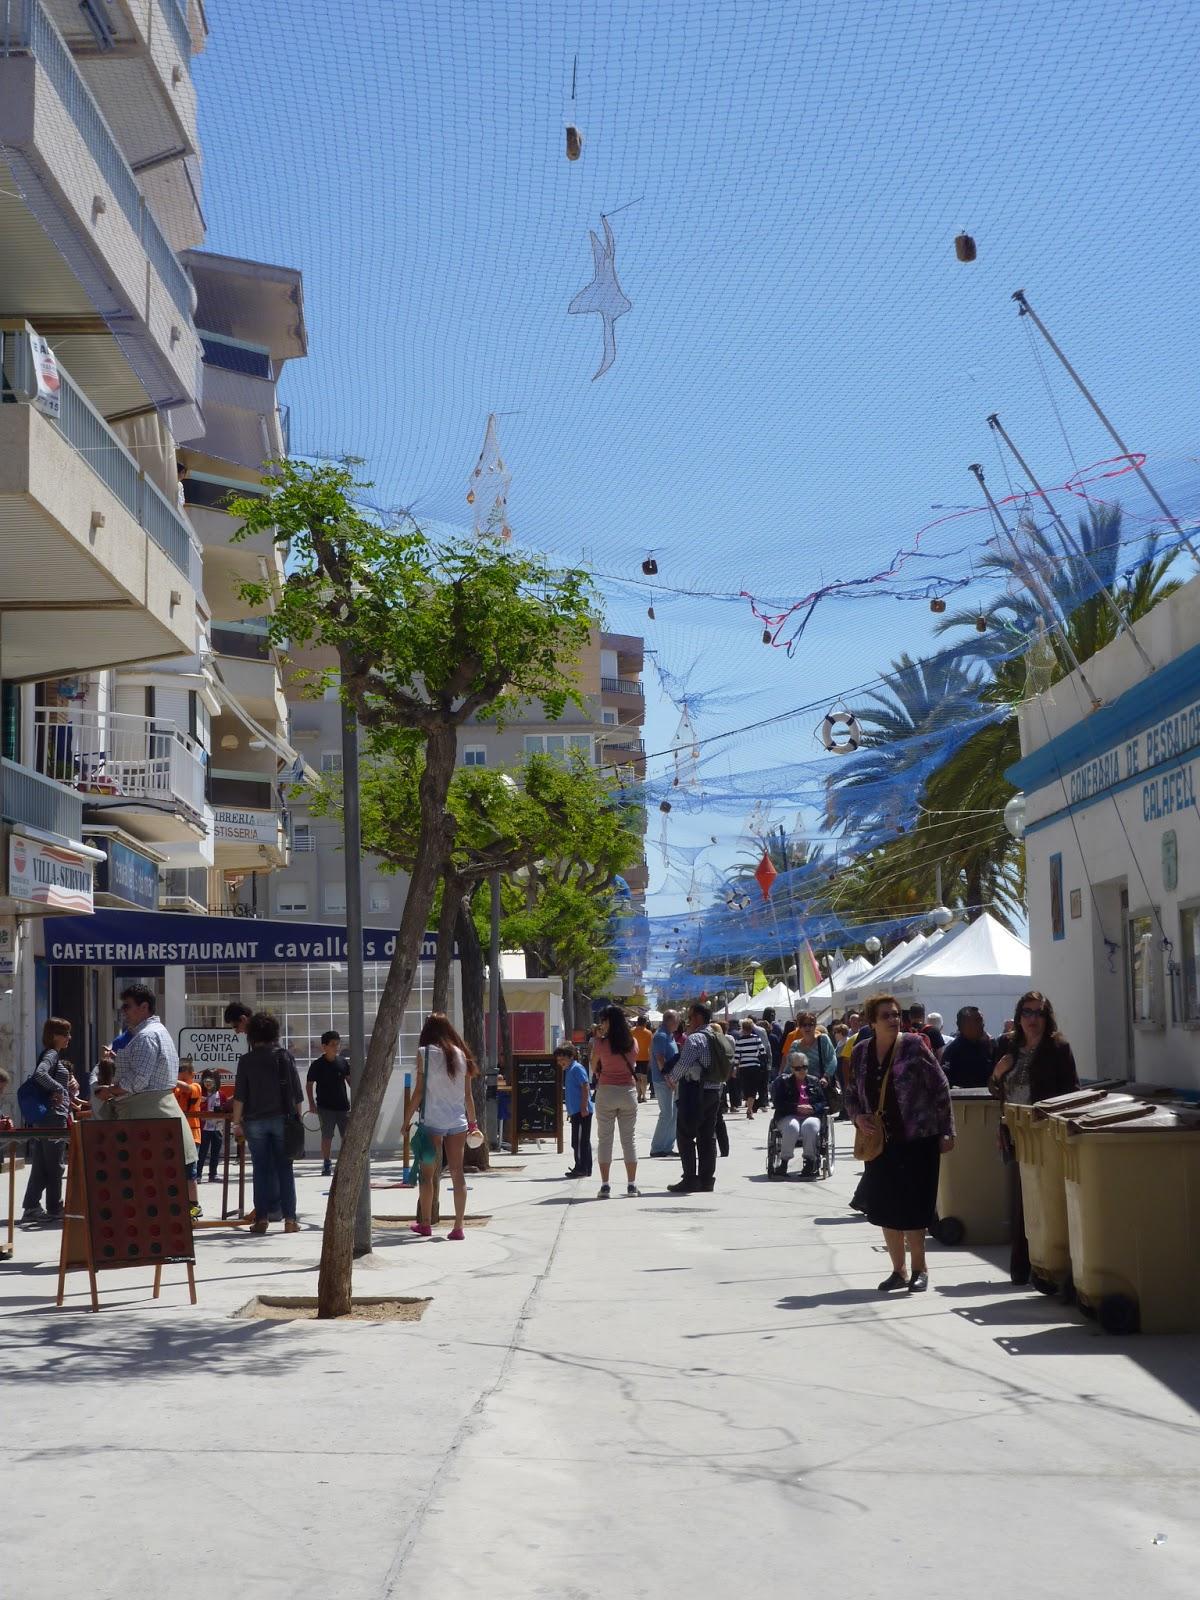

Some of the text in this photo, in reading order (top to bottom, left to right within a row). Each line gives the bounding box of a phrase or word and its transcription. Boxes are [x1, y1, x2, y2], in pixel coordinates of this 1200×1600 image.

[1070, 750, 1120, 802] CONFRARIA
[1126, 740, 1139, 777] DE
[1142, 765, 1196, 822] CALAFELL
[214, 811, 256, 826] IBRERIA
[214, 826, 258, 840] STISSERIA
[190, 1033, 239, 1043] COMPRA
[195, 1043, 233, 1052] VENTA
